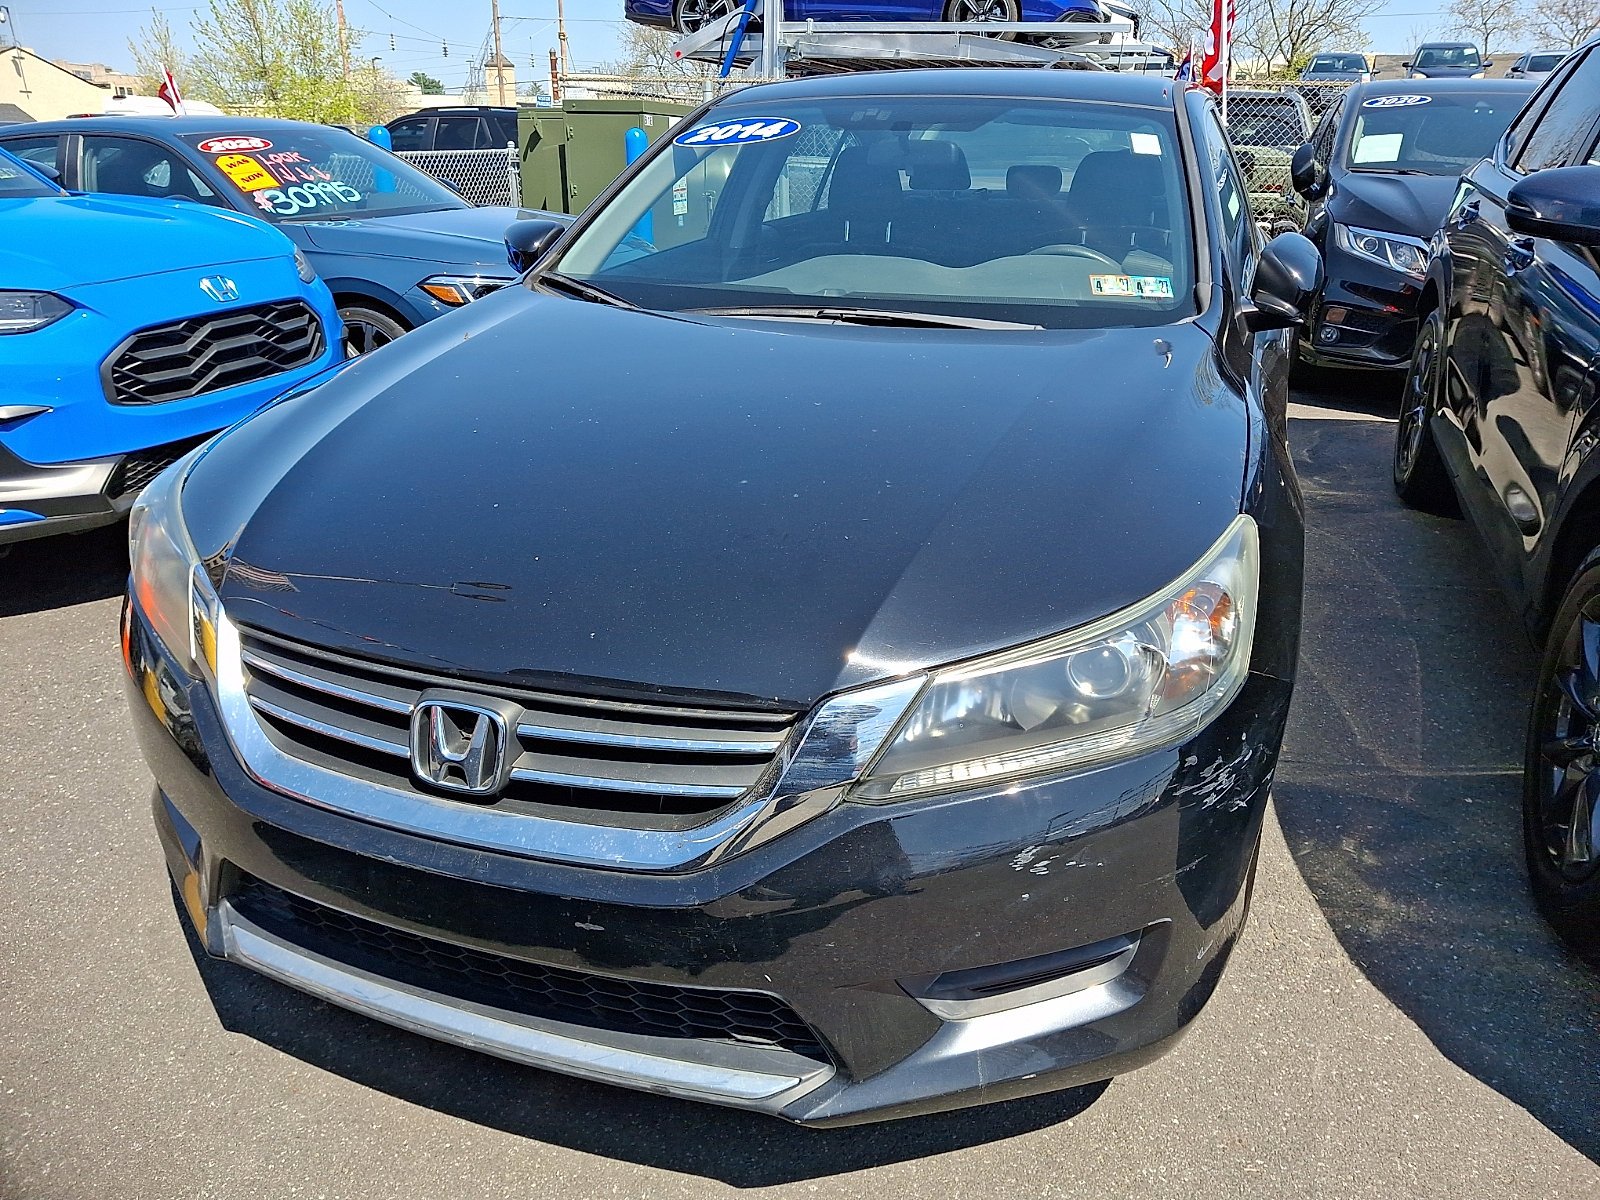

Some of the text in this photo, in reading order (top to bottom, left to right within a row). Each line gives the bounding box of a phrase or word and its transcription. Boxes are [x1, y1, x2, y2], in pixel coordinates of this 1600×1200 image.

[684, 121, 788, 143] 2014
[226, 159, 250, 169] WAS
[240, 172, 264, 183] NOW
